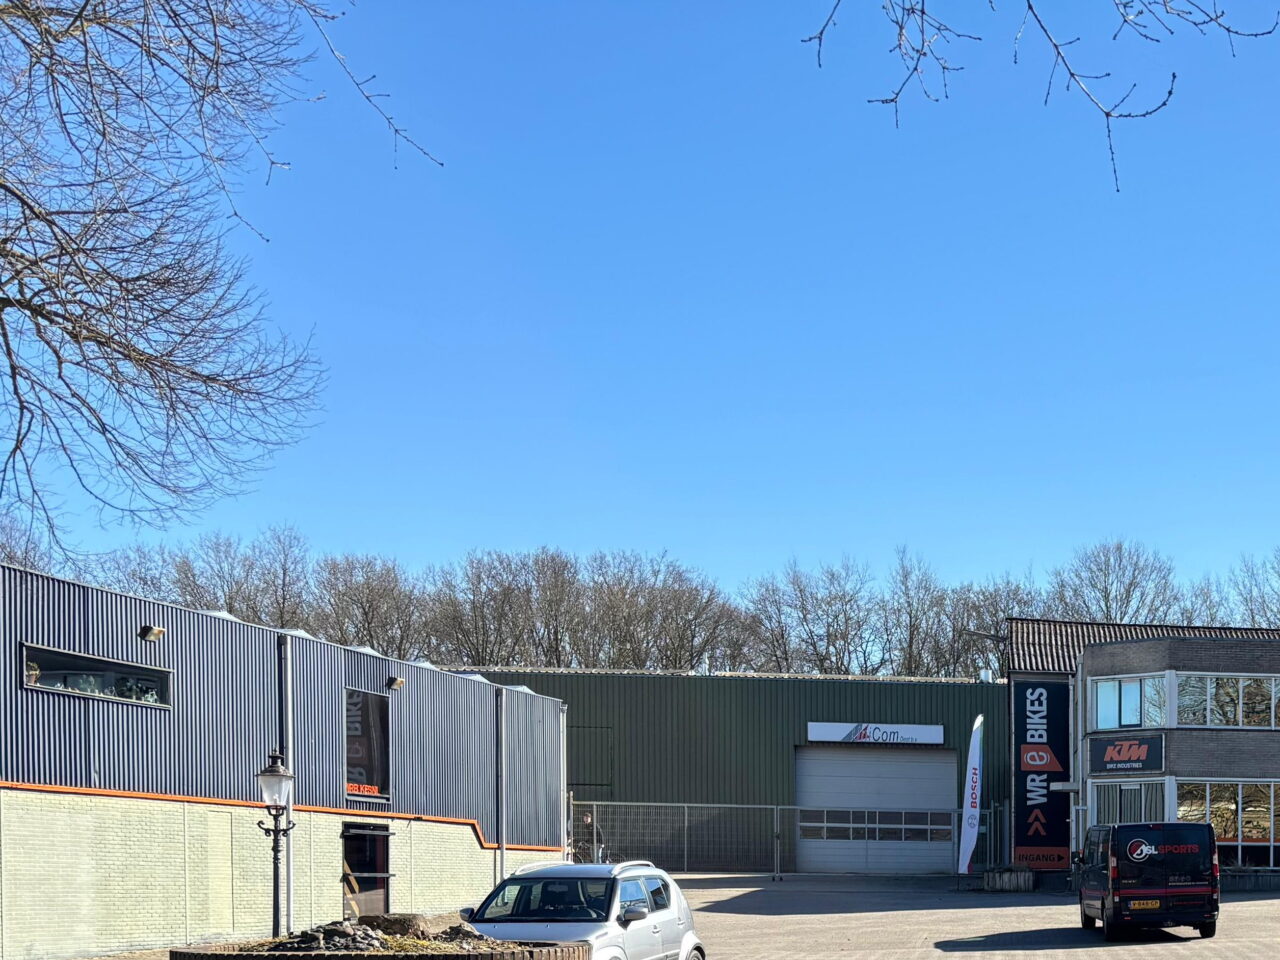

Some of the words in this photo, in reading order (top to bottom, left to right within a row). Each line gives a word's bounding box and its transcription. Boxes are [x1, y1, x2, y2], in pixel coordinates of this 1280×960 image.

[1026, 687, 1048, 743] BIKES
[1104, 741, 1148, 761] KTM
[970, 767, 978, 809] BOSCH
[1026, 774, 1048, 806] WR
[1018, 853, 1056, 862] INGANG
